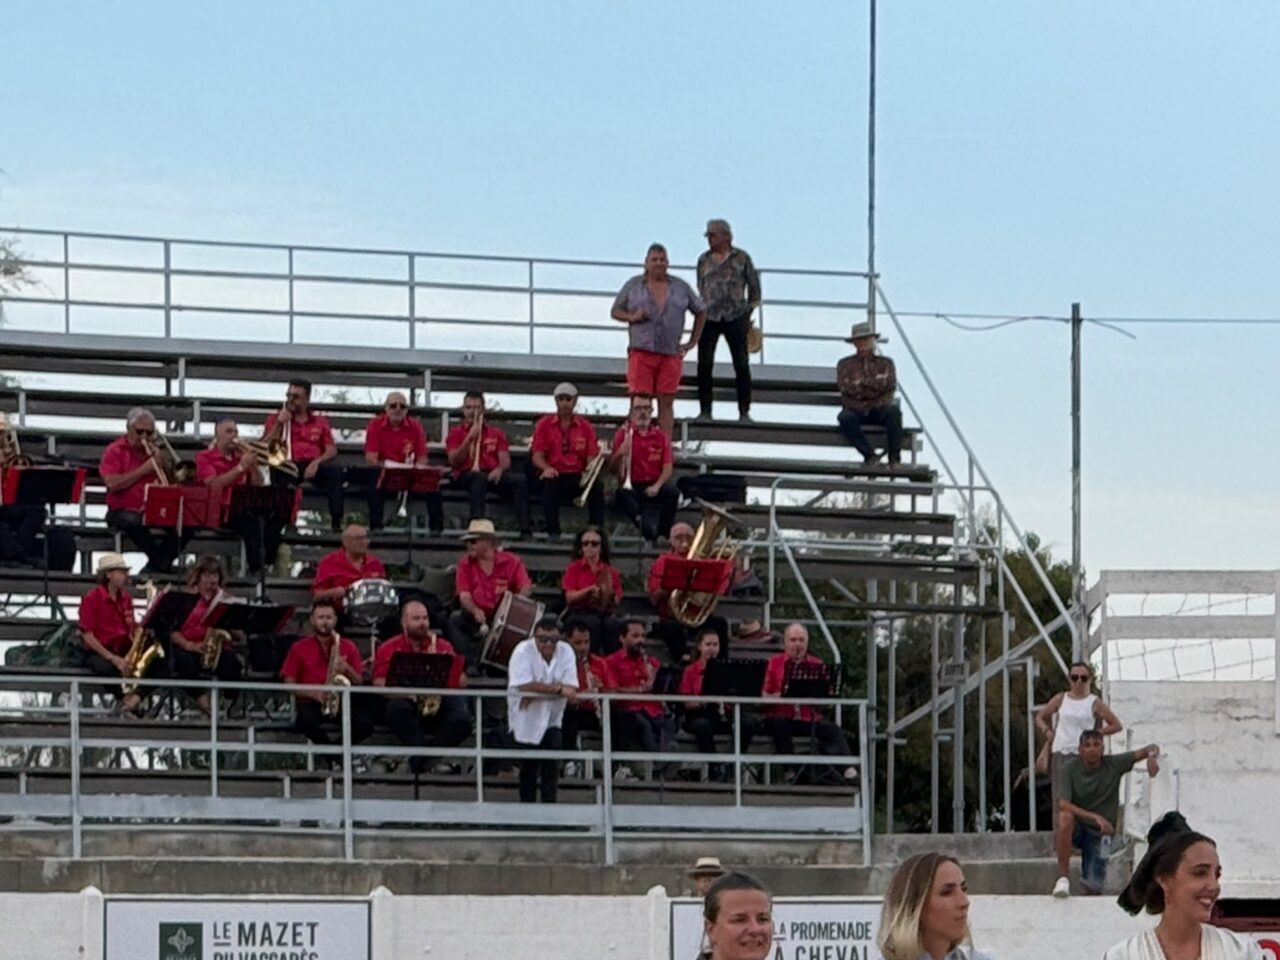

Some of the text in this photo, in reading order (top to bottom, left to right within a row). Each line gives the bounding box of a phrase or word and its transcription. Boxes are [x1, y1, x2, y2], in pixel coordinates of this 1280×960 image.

[213, 921, 319, 947] LE MAZET
[790, 921, 873, 940] PROMENADE
